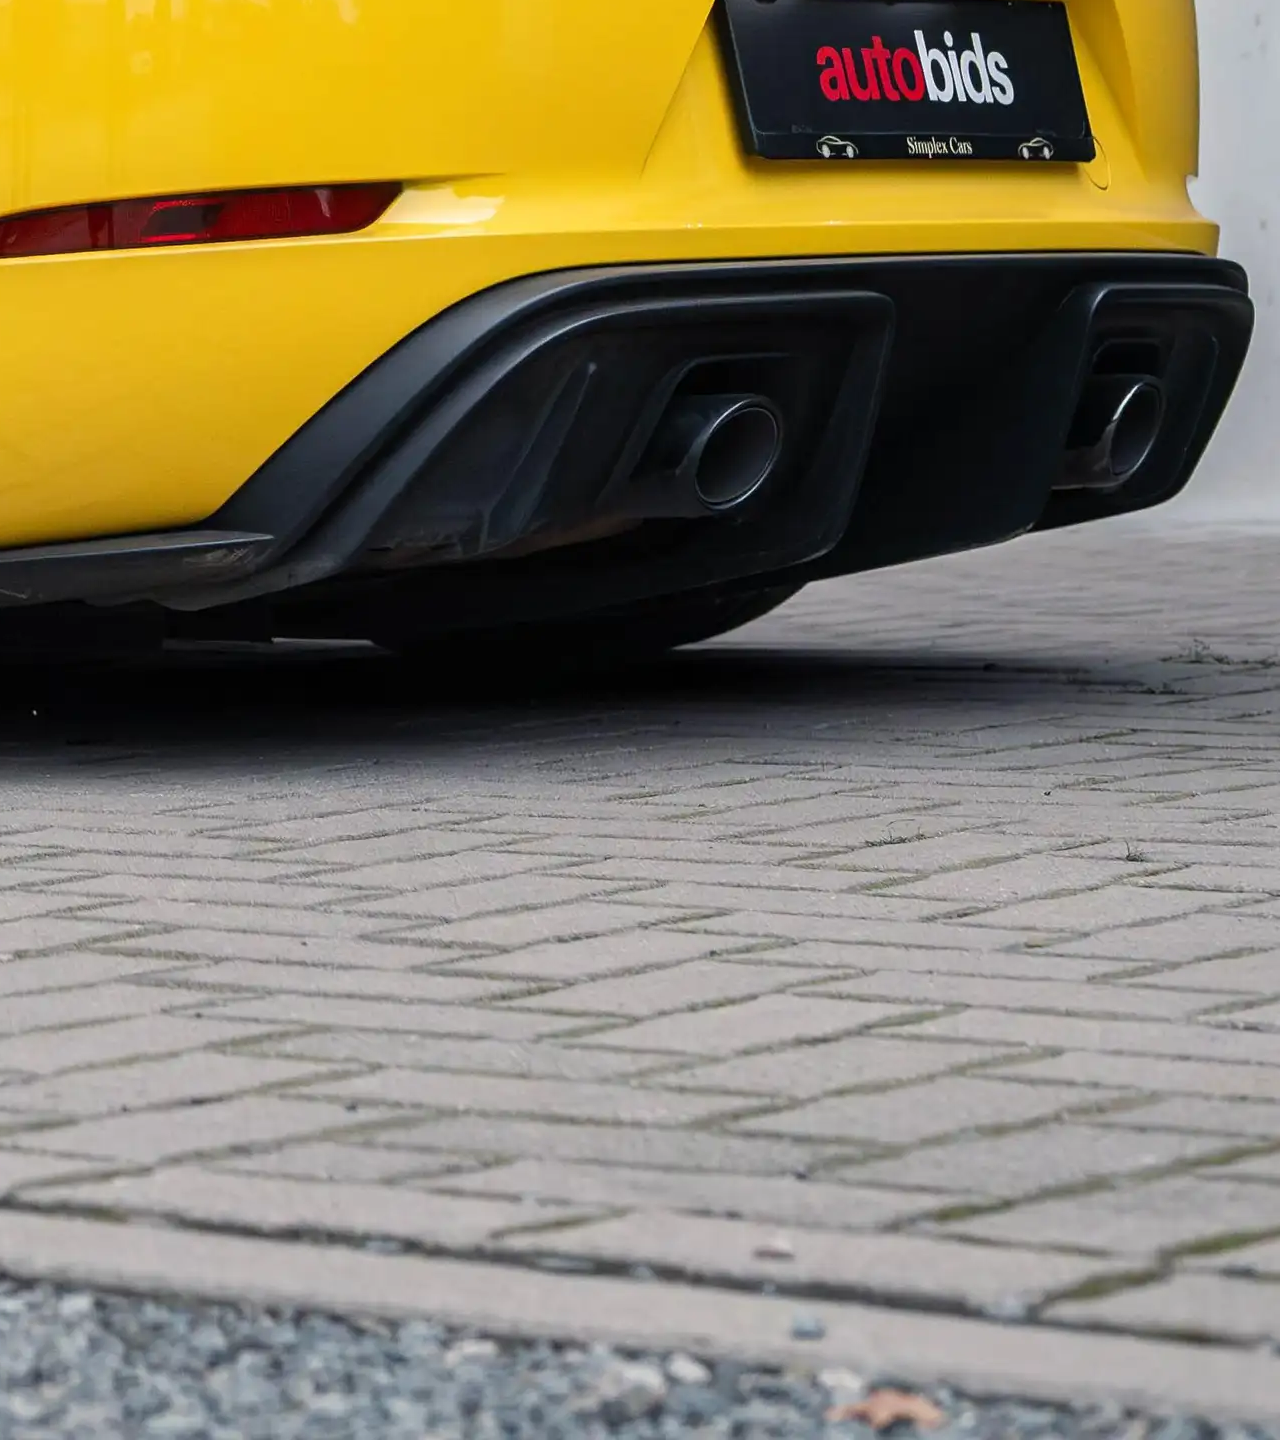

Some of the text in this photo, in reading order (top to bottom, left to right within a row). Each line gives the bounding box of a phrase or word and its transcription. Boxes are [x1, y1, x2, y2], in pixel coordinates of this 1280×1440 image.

[815, 29, 1015, 106] autobids
[905, 135, 973, 159] Simplex Cars
